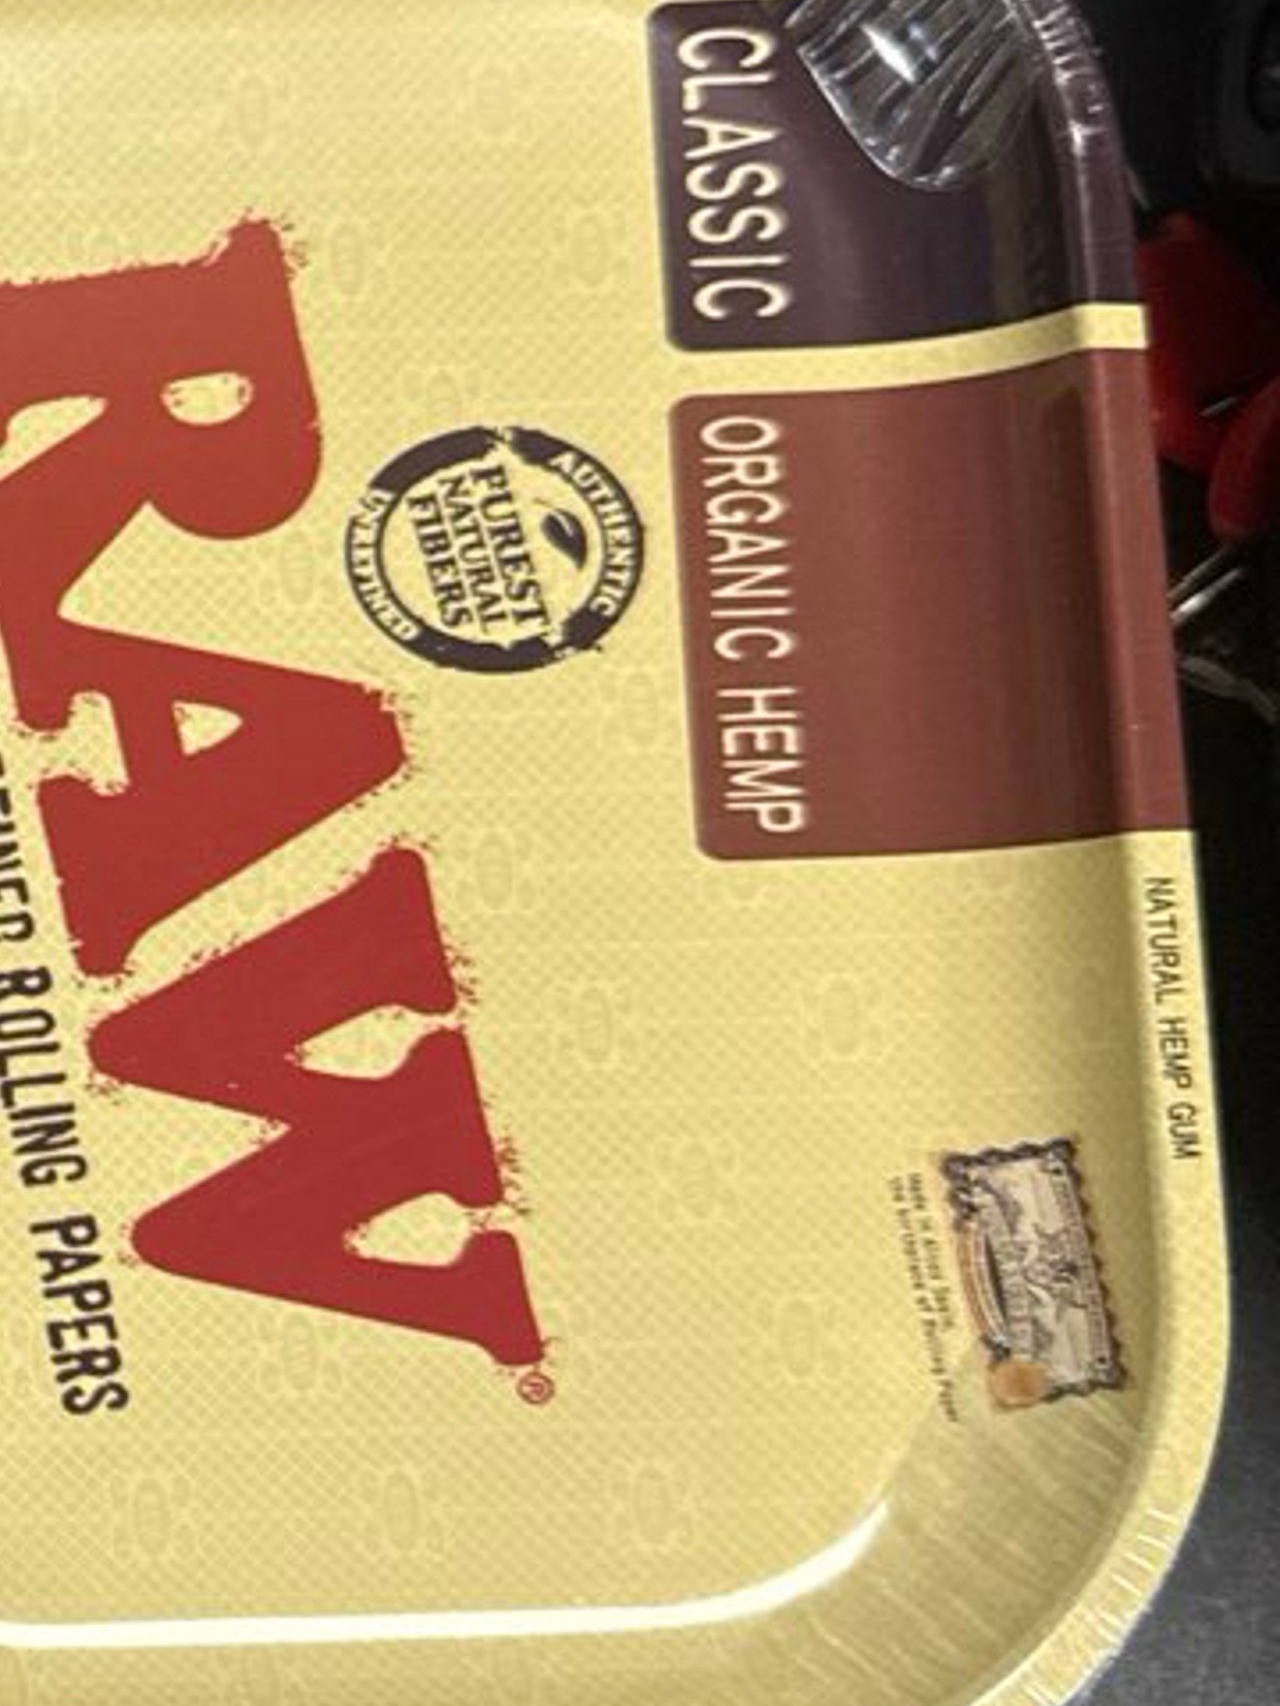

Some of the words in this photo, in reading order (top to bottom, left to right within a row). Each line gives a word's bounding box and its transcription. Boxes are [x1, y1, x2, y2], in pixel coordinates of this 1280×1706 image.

[677, 26, 786, 320] CLASSIC
[351, 491, 418, 641] UNREFINED
[406, 494, 473, 629] FIBERS
[436, 474, 507, 635] NATURAL
[468, 464, 550, 628] PUREST
[548, 451, 632, 617] AUTHENTIC
[698, 414, 791, 661] ORGANIC
[716, 686, 803, 833] HEMP
[1143, 877, 1185, 1005] NATURAL
[1157, 1016, 1191, 1089] HEMP
[1165, 1101, 1202, 1160] GUM
[27, 1215, 128, 1416] PAPERS
